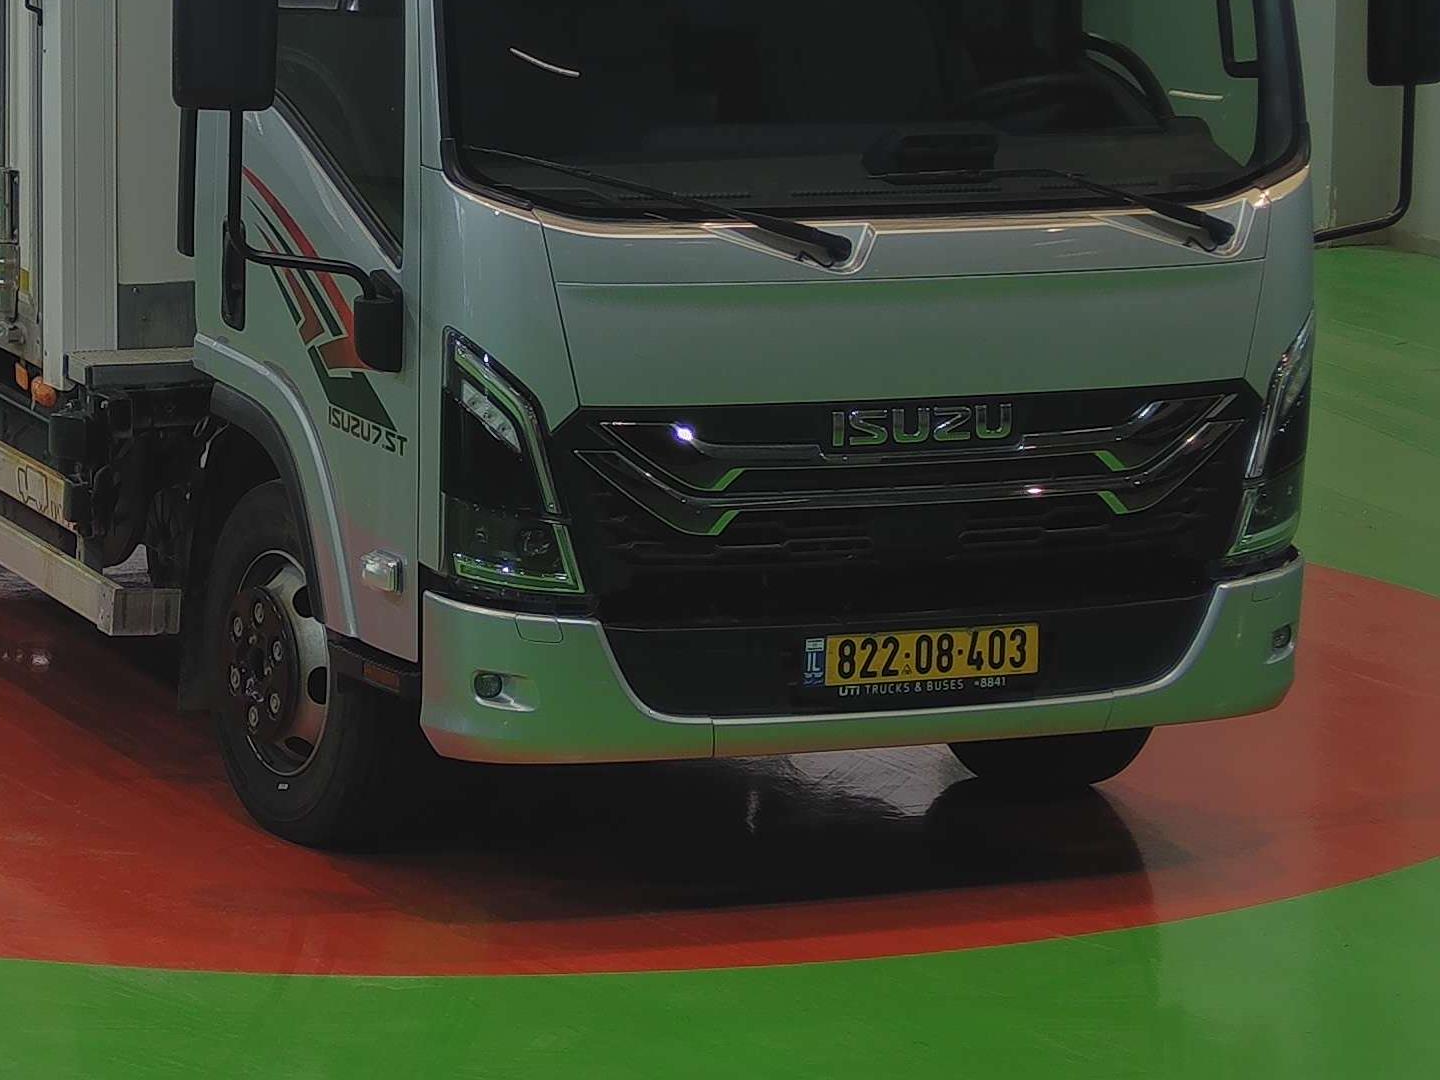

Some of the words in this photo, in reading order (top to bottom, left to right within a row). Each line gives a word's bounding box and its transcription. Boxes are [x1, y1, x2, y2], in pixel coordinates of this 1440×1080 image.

[832, 403, 1013, 447] ISUZU
[806, 652, 821, 672] IL
[863, 682, 911, 696] TRUCKS
[914, 681, 923, 693] &
[926, 679, 965, 693] BUSES
